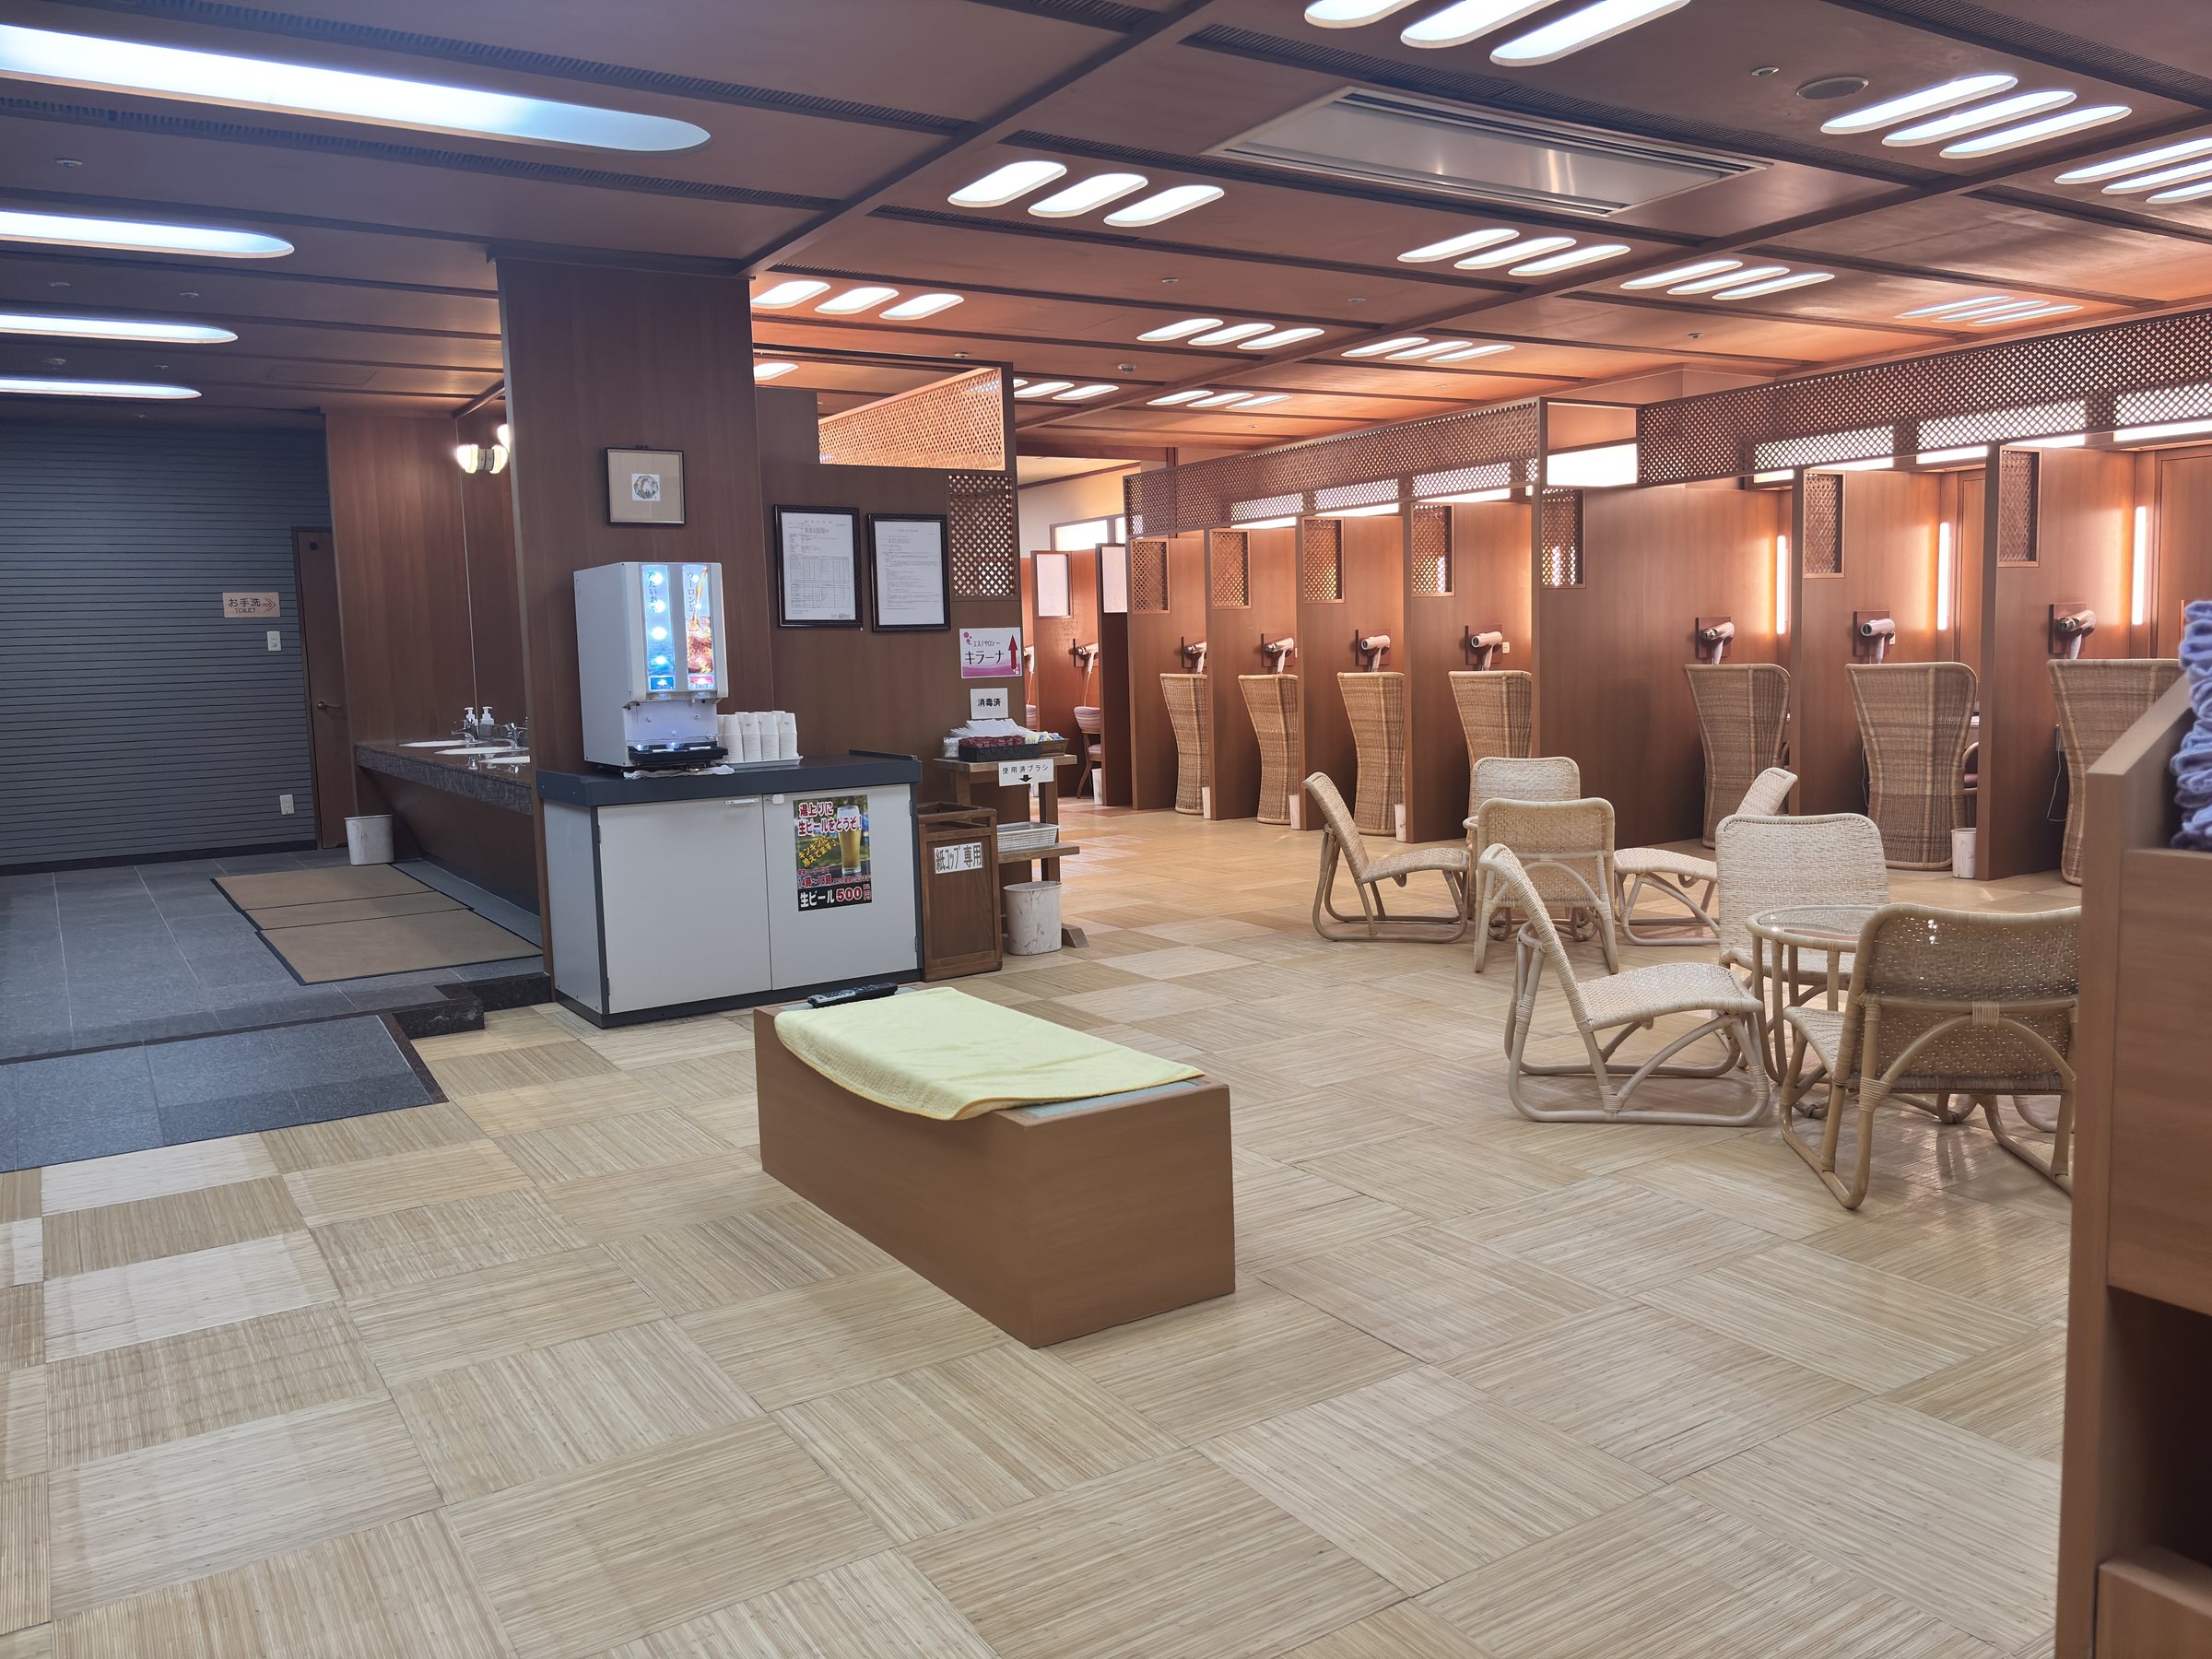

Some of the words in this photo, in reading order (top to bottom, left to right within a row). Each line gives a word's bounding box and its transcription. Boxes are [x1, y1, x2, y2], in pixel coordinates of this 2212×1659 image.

[687, 571, 700, 613] ウーロン茶
[229, 597, 261, 607] お手洗
[964, 650, 1005, 665] キラーナ
[977, 698, 1001, 707] 消毒済
[1002, 764, 1049, 775] 使用済ブラシ
[798, 801, 834, 818] 湯上りに
[798, 835, 829, 859] キンキンに
